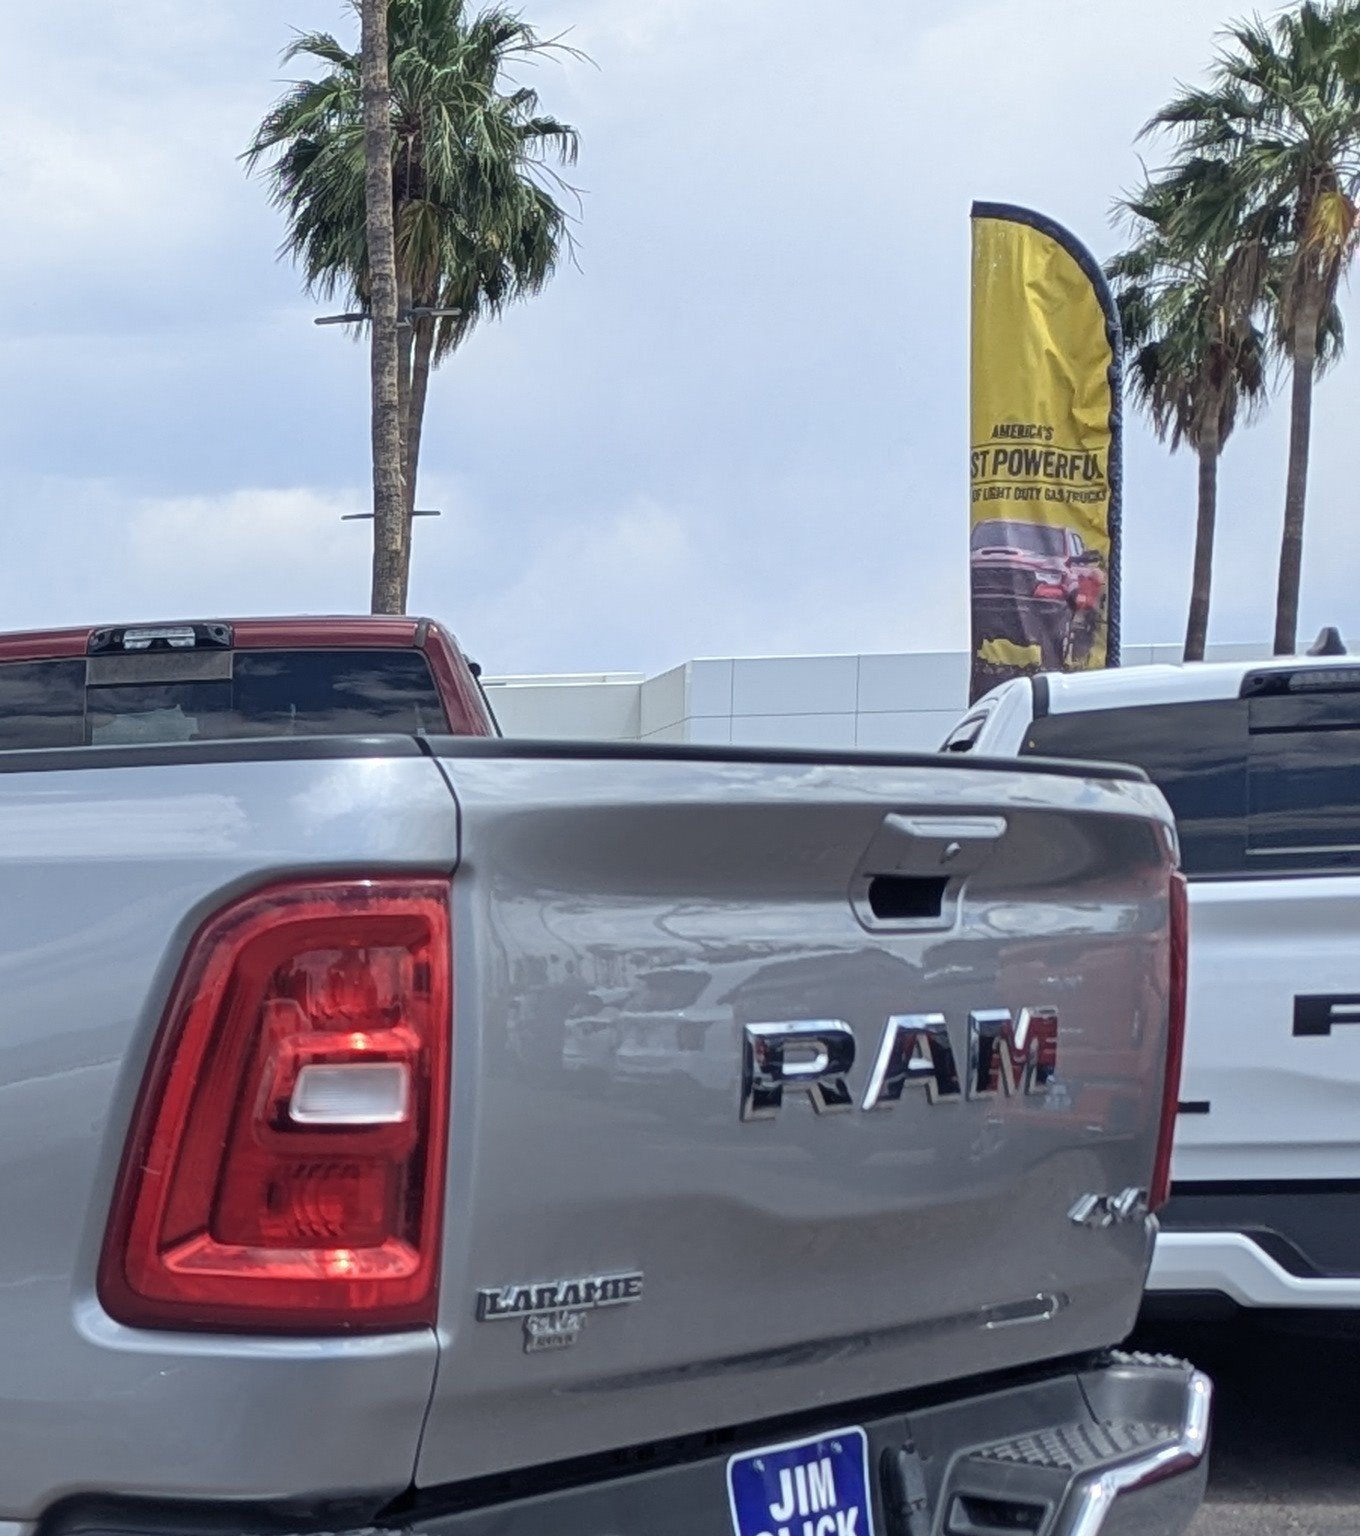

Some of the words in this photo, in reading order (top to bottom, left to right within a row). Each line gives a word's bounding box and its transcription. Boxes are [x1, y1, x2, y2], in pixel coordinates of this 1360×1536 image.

[991, 424, 1054, 441] AMERICA'S
[983, 486, 1012, 501] LIGHT
[1014, 486, 1042, 501] DUTY
[740, 1006, 1059, 1122] RAM
[480, 1272, 643, 1319] LARAMIE
[769, 1457, 837, 1522] JIM
